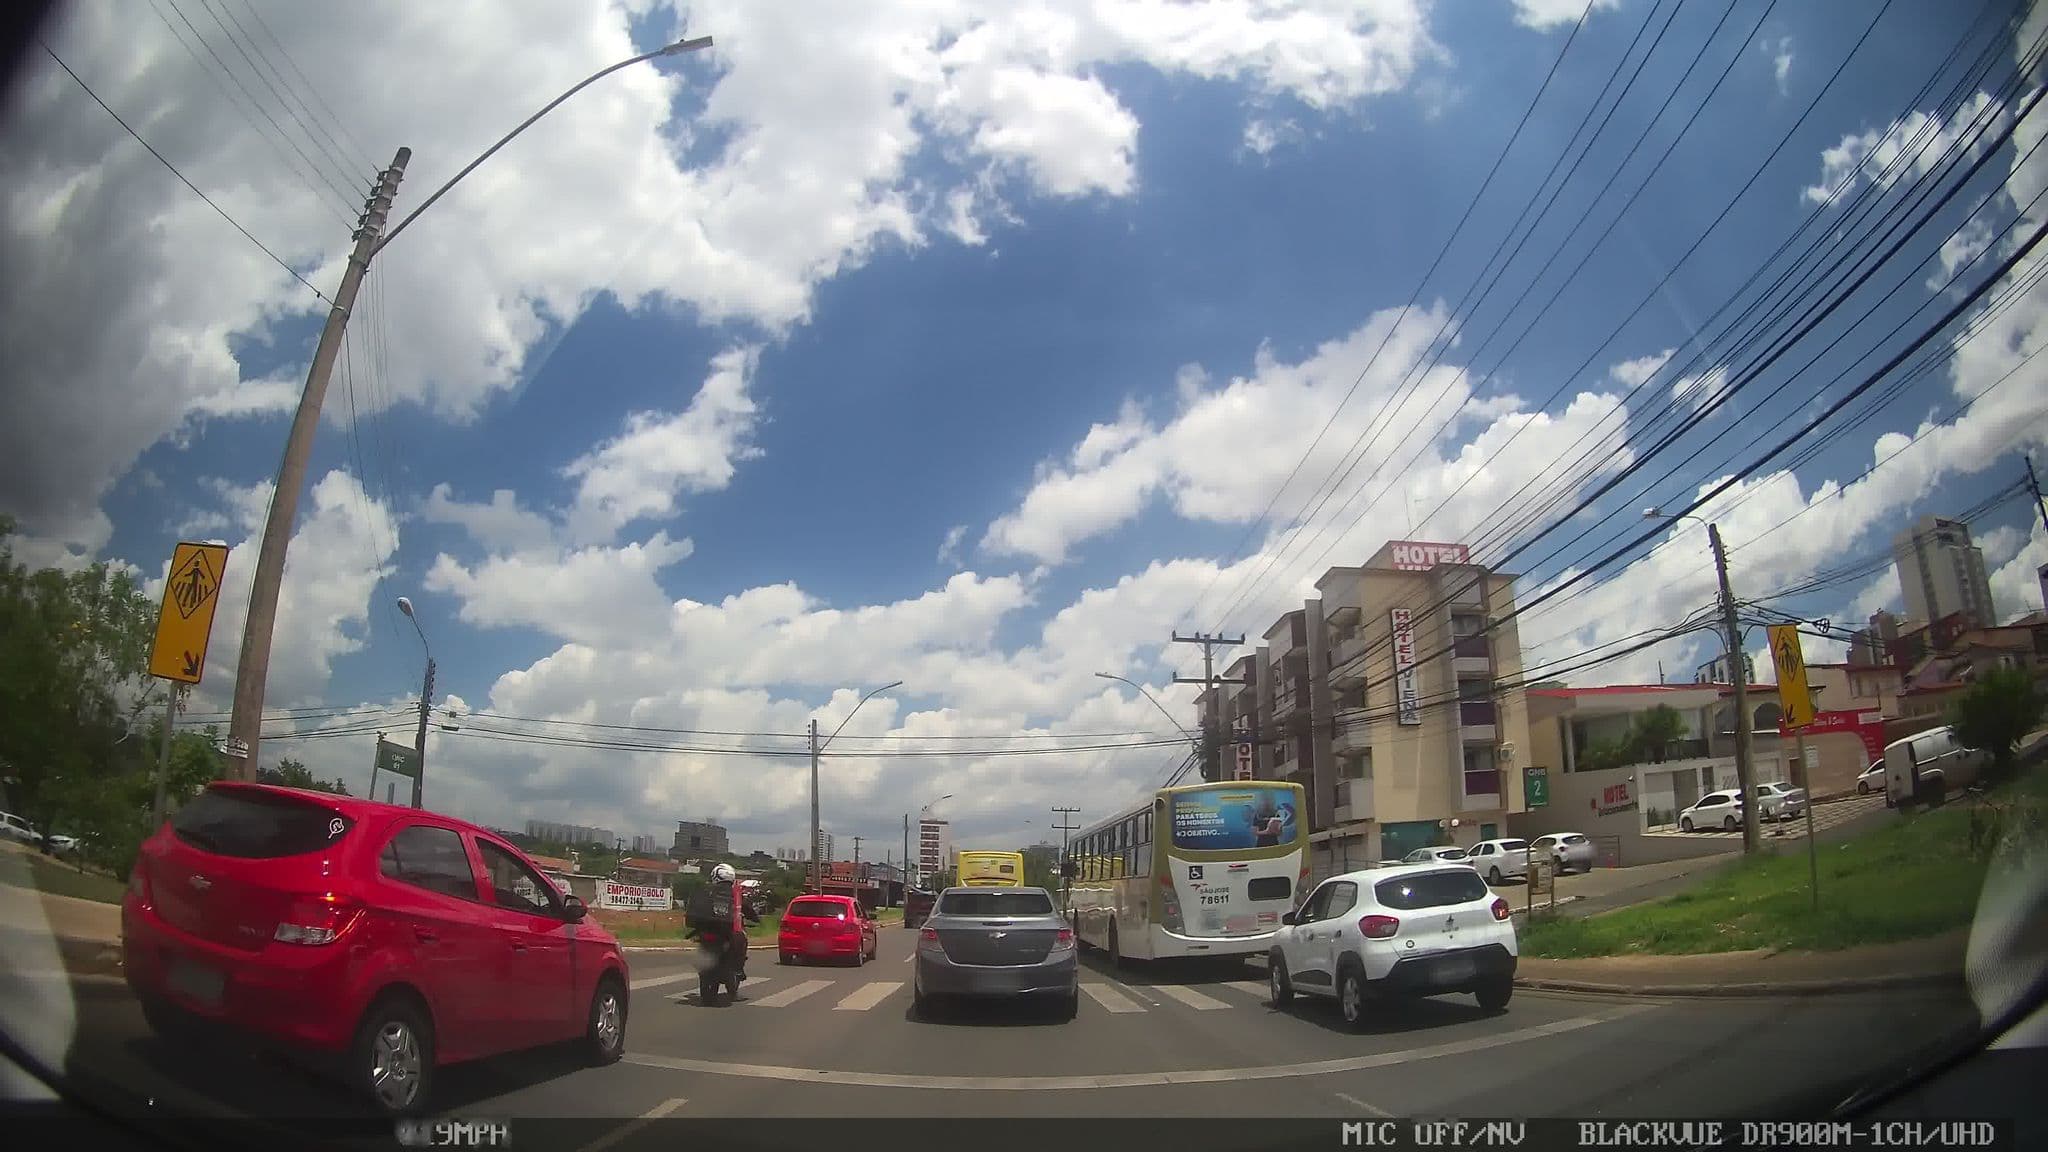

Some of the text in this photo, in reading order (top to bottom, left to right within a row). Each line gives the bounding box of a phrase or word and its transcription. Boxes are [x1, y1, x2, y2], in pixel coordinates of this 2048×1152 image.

[1392, 545, 1468, 565] HOTEL
[1395, 611, 1412, 664] HOTEL
[1534, 780, 1541, 796] 2
[607, 884, 642, 897] EMPORIO
[1199, 895, 1229, 905] 78611
